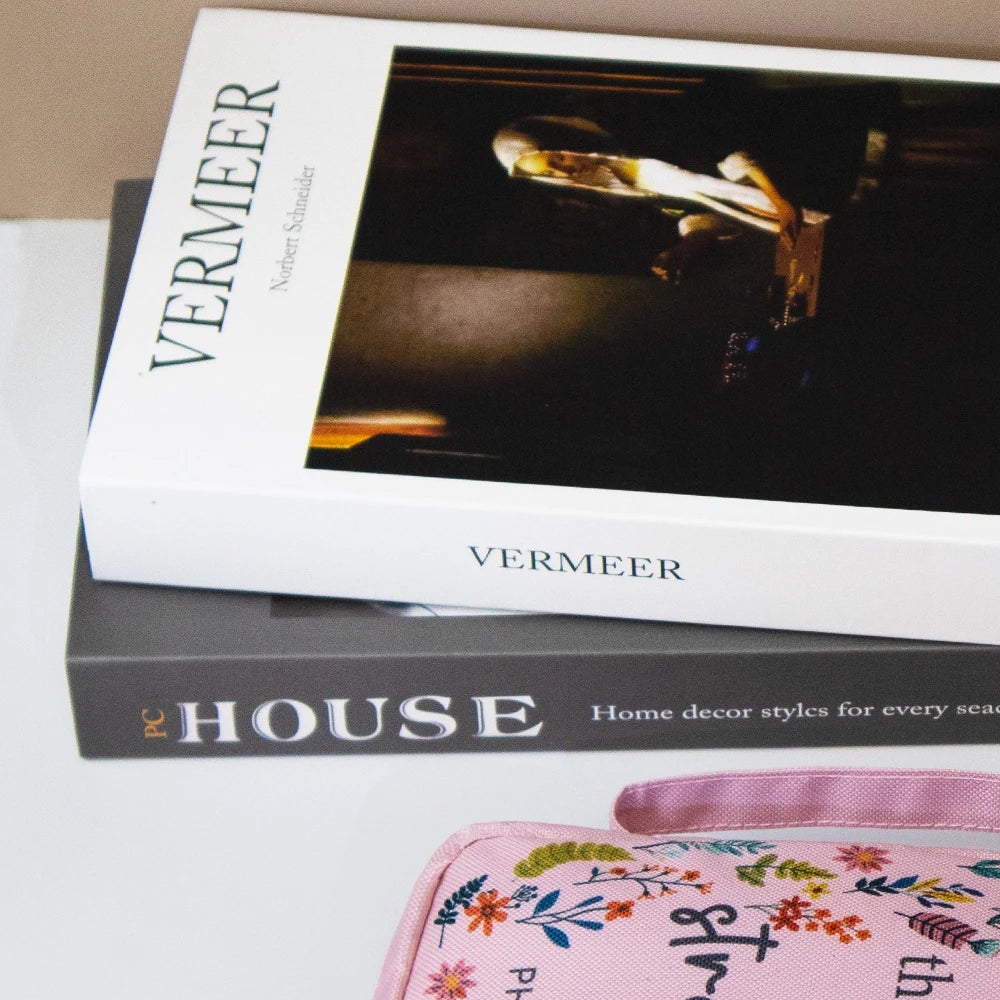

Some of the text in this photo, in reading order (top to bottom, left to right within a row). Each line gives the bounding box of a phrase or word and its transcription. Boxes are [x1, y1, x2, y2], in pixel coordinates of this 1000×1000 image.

[149, 80, 281, 371] VERMEER
[269, 164, 316, 293] Norbert Schneider
[468, 545, 686, 581] VERMEER
[142, 708, 167, 739] PC
[177, 695, 544, 744] HOUSE
[591, 705, 673, 721] Home
[682, 704, 752, 720] decor
[837, 701, 874, 717] for
[882, 703, 949, 720] every
